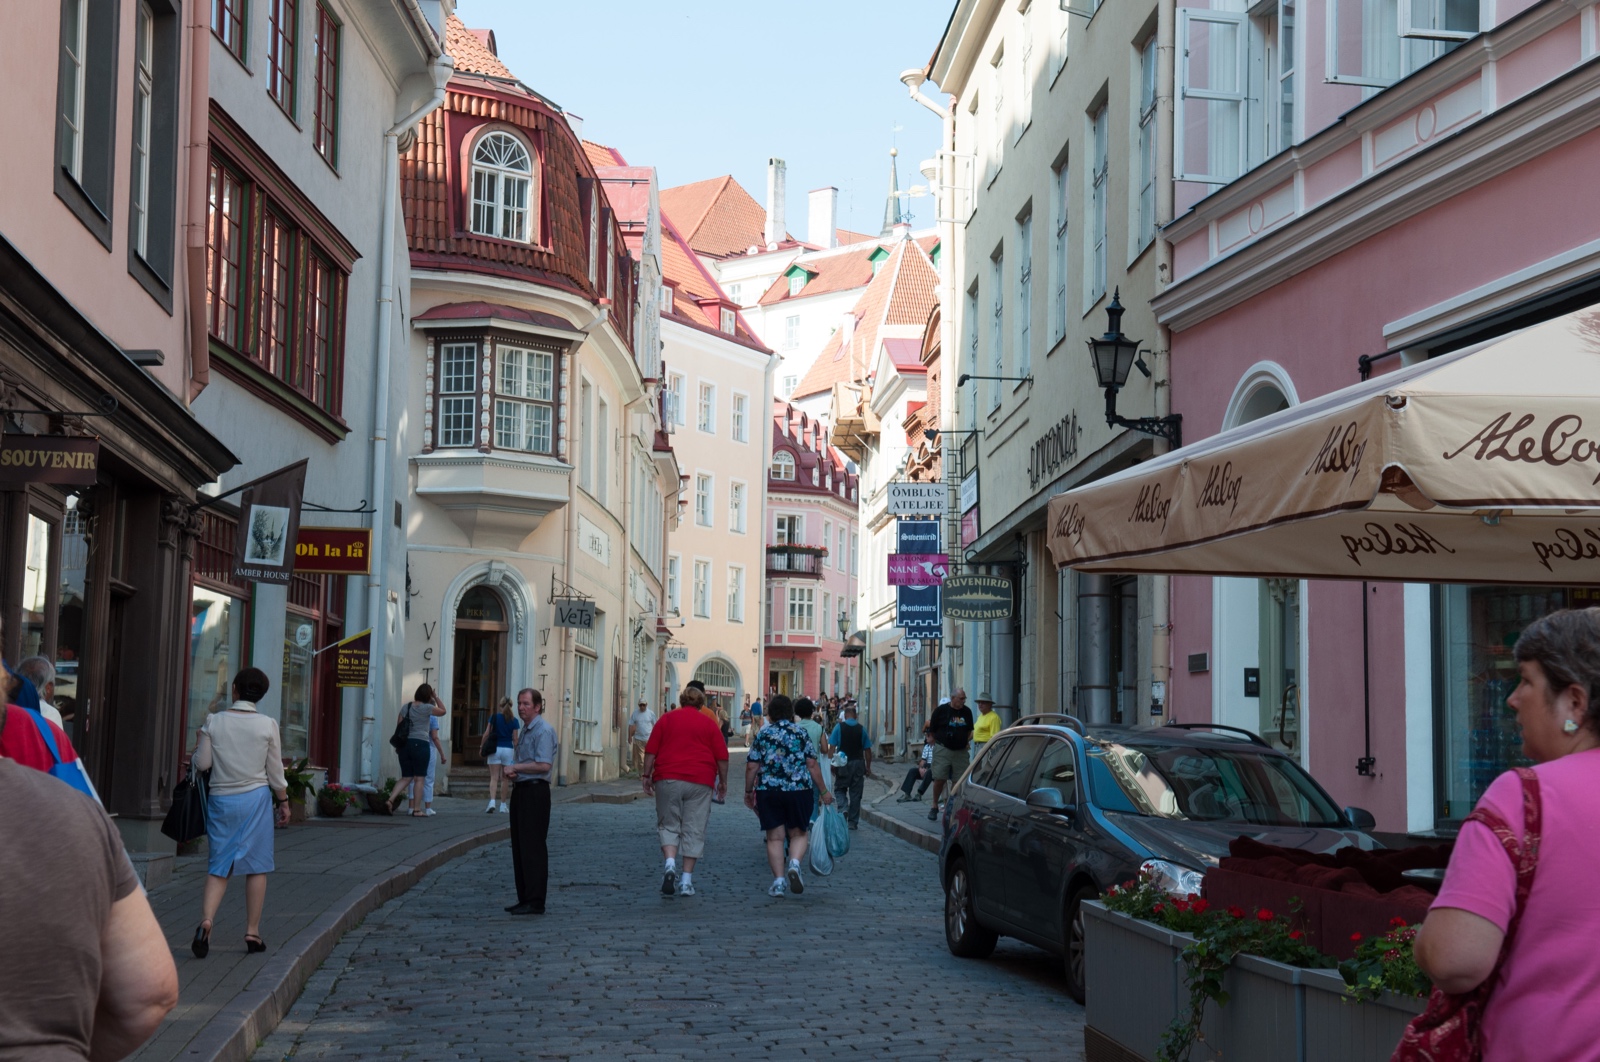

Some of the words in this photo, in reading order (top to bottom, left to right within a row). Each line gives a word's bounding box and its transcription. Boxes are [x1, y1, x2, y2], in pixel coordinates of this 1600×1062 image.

[1029, 408, 1077, 489] LIVONIA
[0, 449, 96, 469] SOUVENIR
[892, 486, 945, 497] ÕMBLUS-
[892, 501, 944, 510] ATELJEE
[900, 533, 937, 541] Suveniirid
[295, 543, 319, 557] Oh
[324, 544, 341, 557] la
[346, 545, 363, 558] la
[234, 568, 262, 578] AMBER
[263, 571, 290, 581] HOUSE
[889, 566, 918, 574] NALNE
[946, 577, 1009, 589] SUVENIIRID
[900, 603, 937, 612] Souvenirs
[946, 607, 1009, 619] SOUVENIRS
